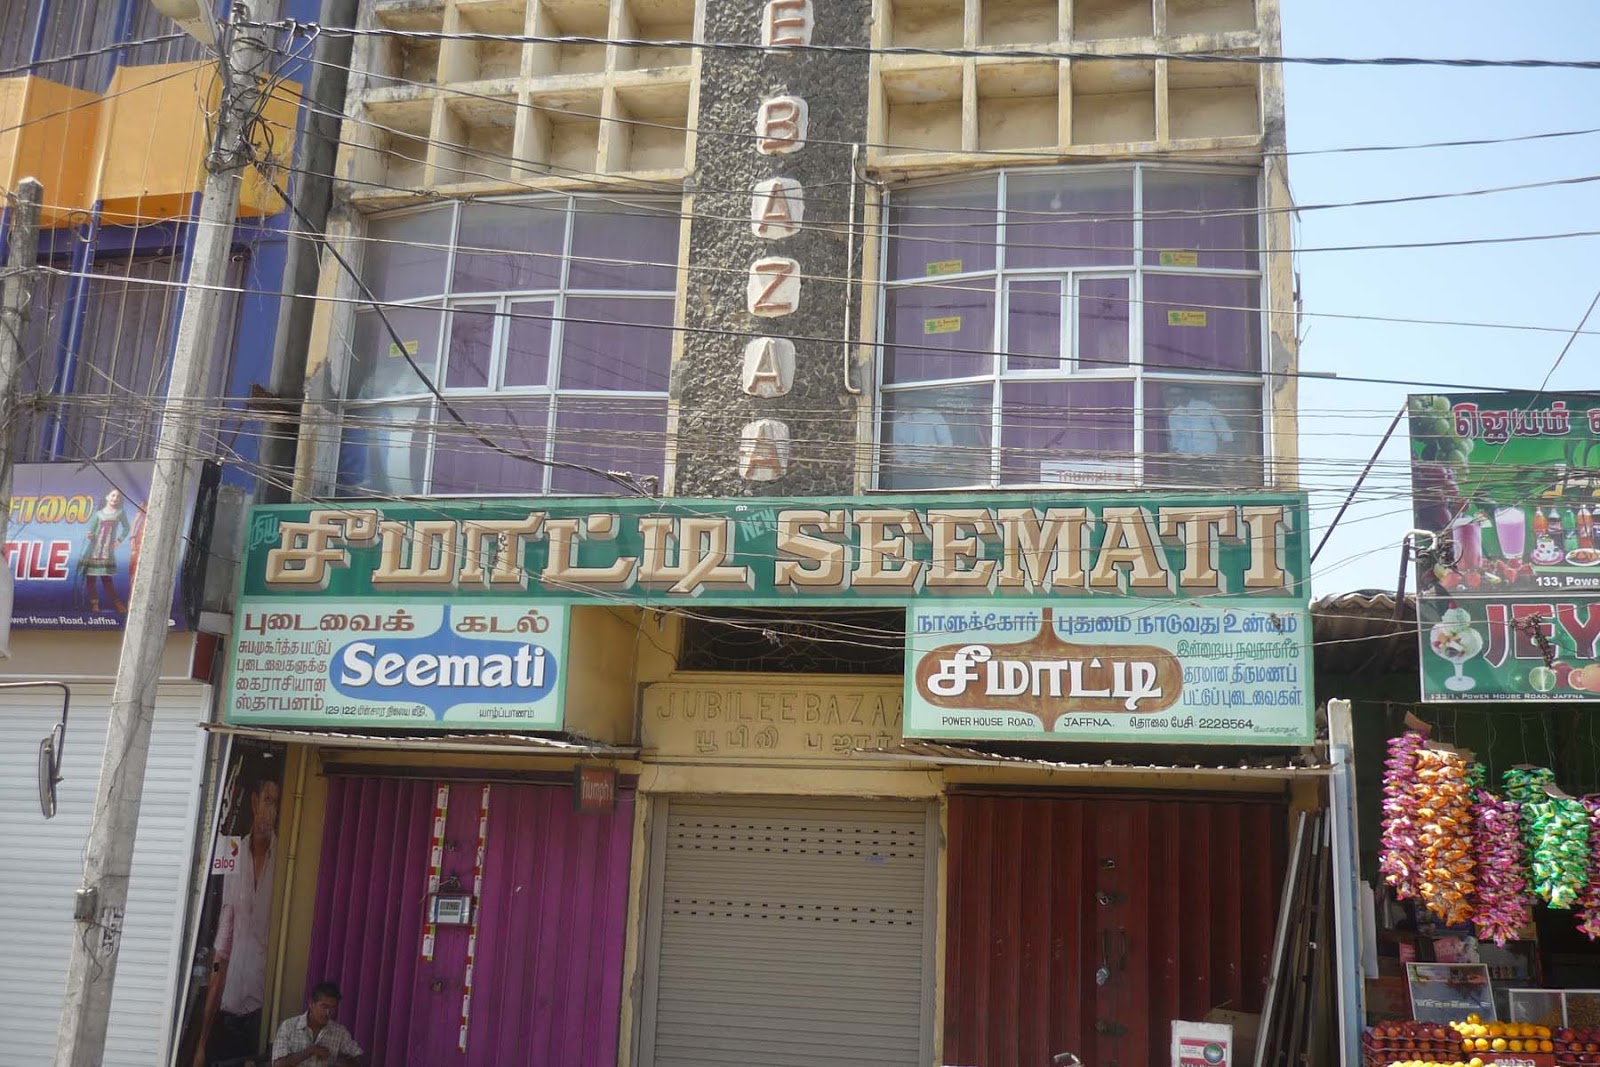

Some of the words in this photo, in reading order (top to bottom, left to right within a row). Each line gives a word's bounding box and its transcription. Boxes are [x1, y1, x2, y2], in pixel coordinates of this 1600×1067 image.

[265, 508, 754, 597] சீமாட்டி
[741, 508, 777, 541] NEW
[775, 505, 1295, 592] SEEMATI
[1535, 576, 1562, 588] 133,
[30, 616, 58, 625] House
[455, 609, 550, 634] கடல்
[340, 641, 546, 687] Seemati
[927, 645, 1162, 711] சீமாட்டி
[942, 716, 971, 726] POWER
[973, 716, 1003, 727] HOUSE
[1198, 718, 1254, 729] 2228564
[214, 856, 235, 871] alog
